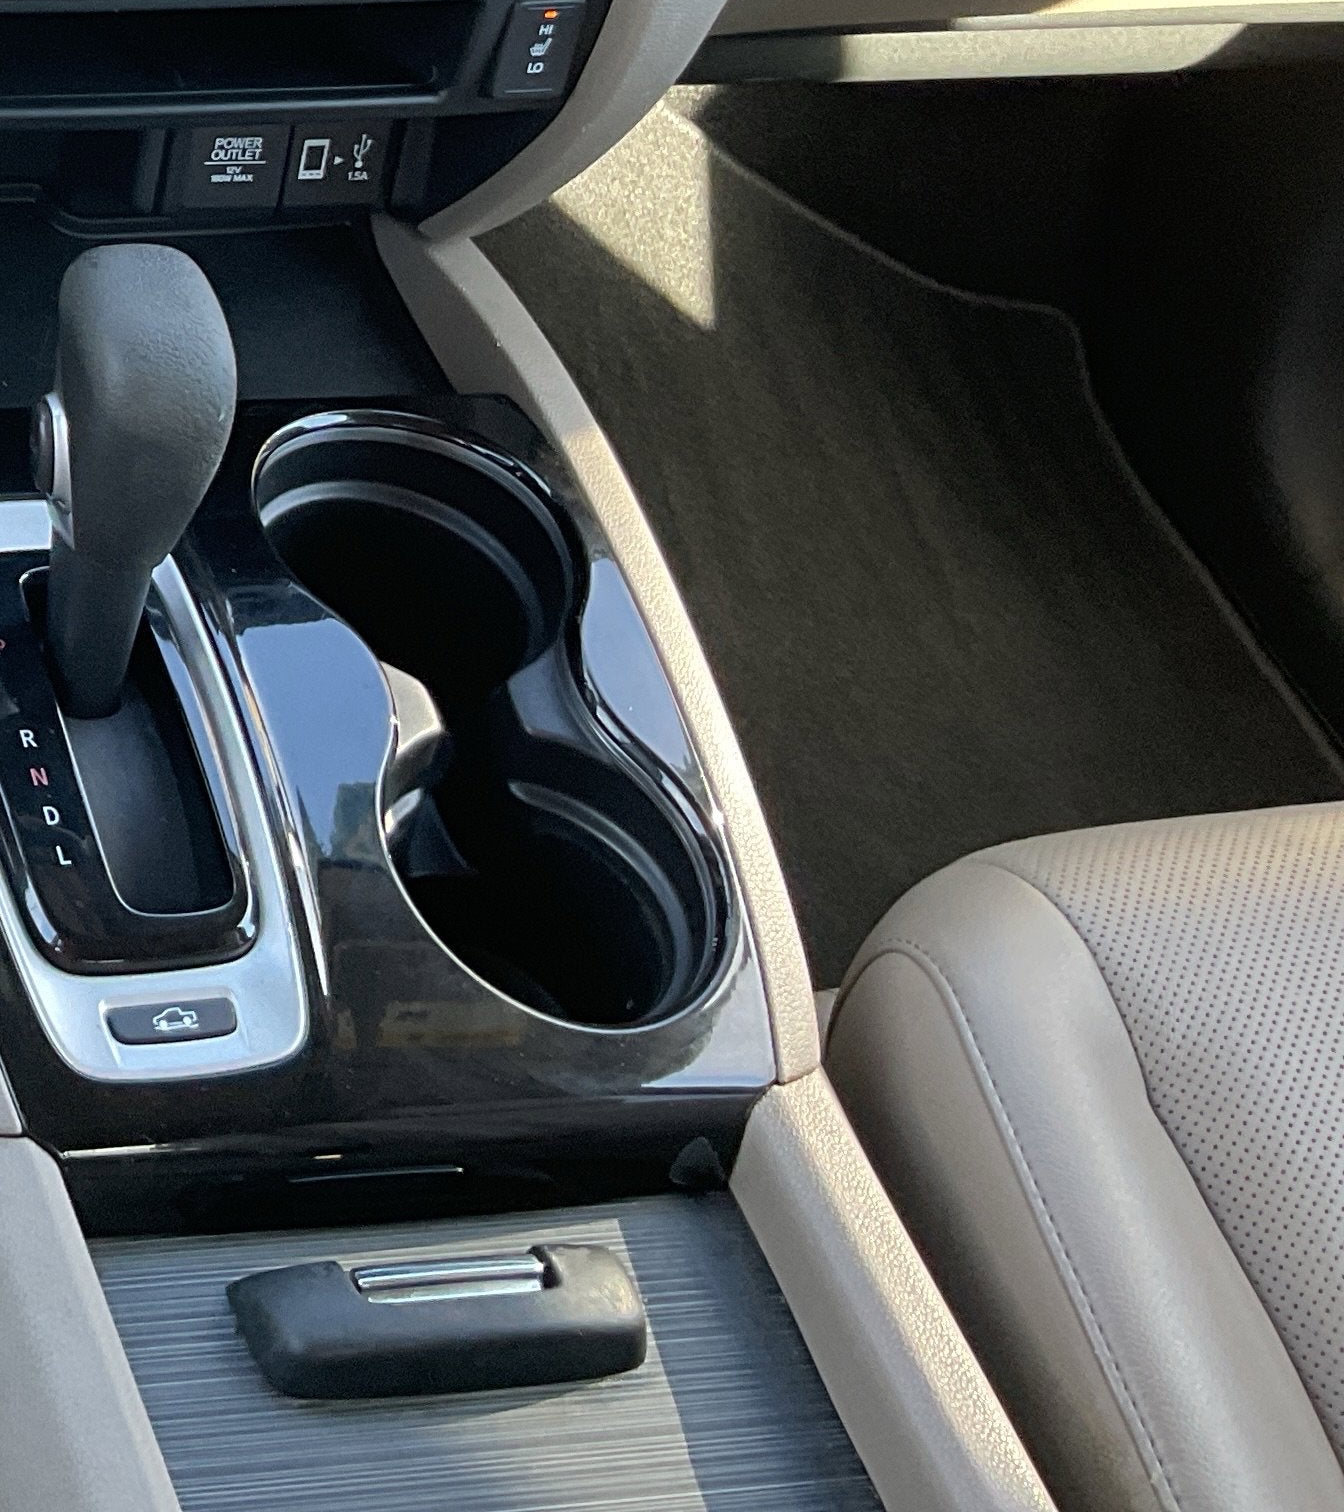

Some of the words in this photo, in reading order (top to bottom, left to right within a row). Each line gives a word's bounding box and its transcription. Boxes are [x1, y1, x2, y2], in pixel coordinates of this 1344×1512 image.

[538, 24, 555, 37] HI
[526, 61, 545, 74] LO
[214, 136, 263, 150] POWER
[210, 148, 263, 161] OUTLET
[19, 728, 39, 750] R
[30, 766, 50, 789] N
[42, 804, 60, 826] D
[56, 844, 72, 866] L
